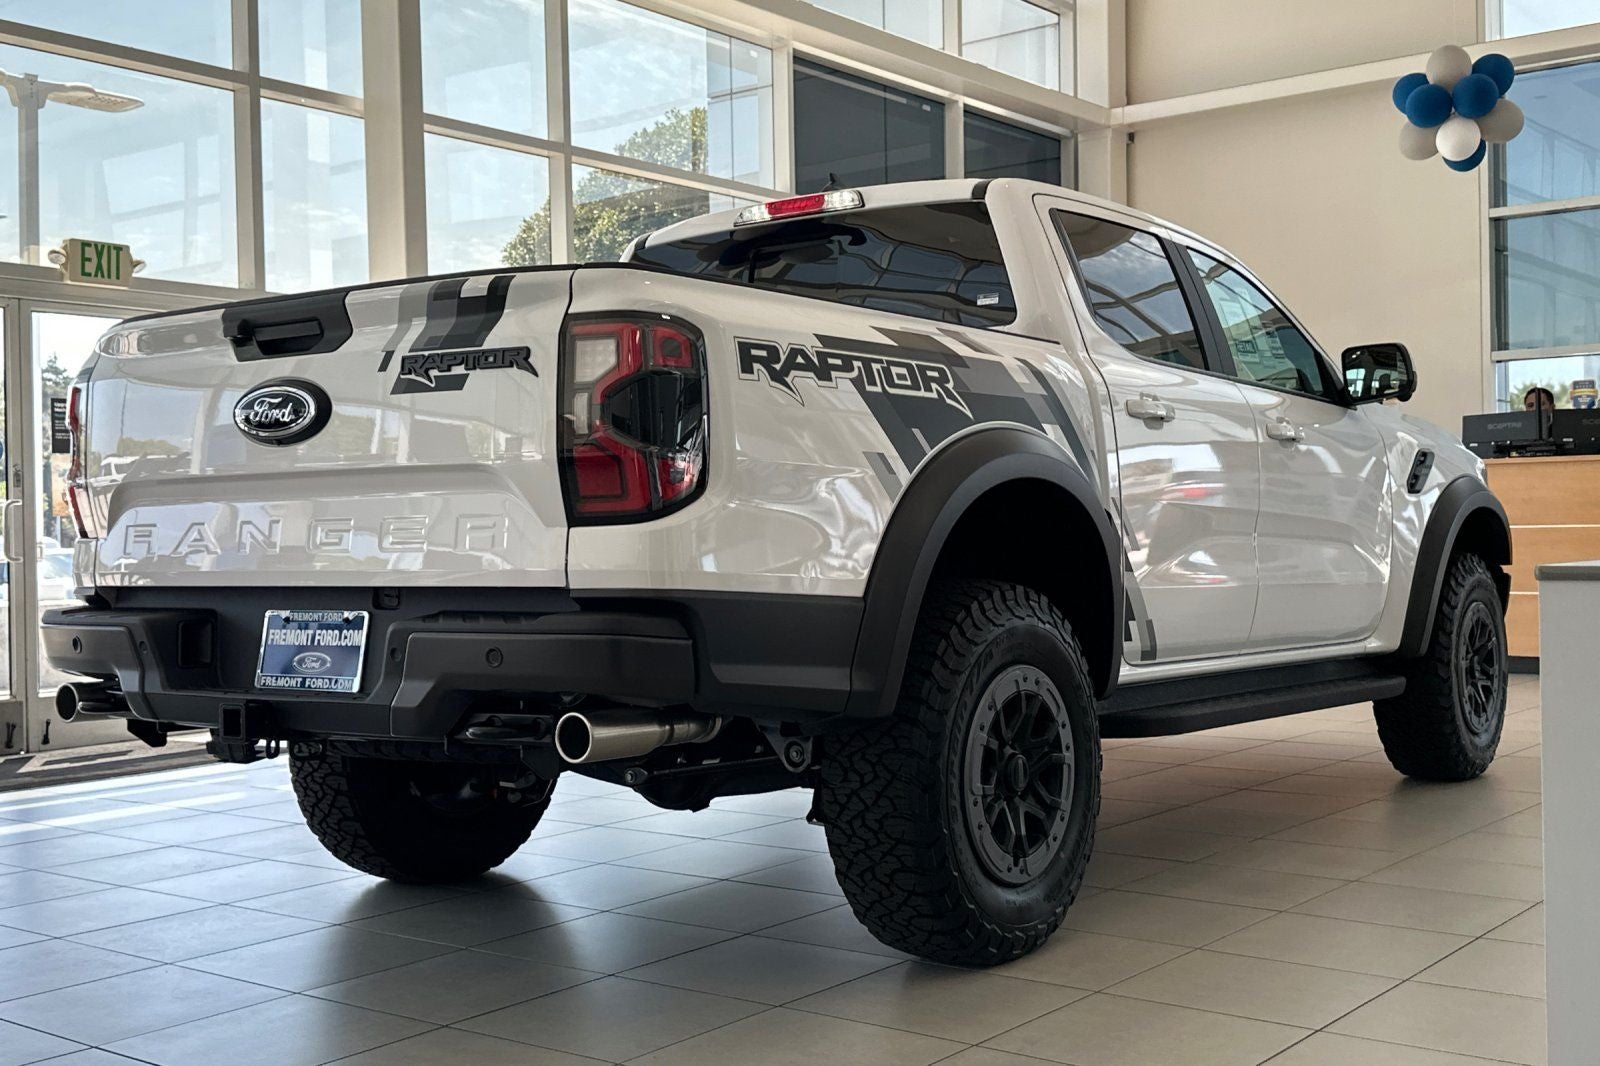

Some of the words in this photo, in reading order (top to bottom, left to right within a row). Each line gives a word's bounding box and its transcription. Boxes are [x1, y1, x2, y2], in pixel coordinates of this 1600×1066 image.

[80, 241, 123, 280] EXIT
[400, 346, 539, 385] RAPTOR
[735, 336, 974, 420] RAPTOR
[250, 397, 293, 422] Ford
[123, 513, 508, 559] RANGER
[289, 612, 323, 622] FREMONT
[324, 613, 343, 622] FORD
[267, 629, 314, 646] FREMONT
[314, 629, 363, 647] FORD.COM
[302, 656, 322, 669] Ford
[260, 676, 303, 688] FREMONT
[305, 678, 353, 690] FORD.COM
